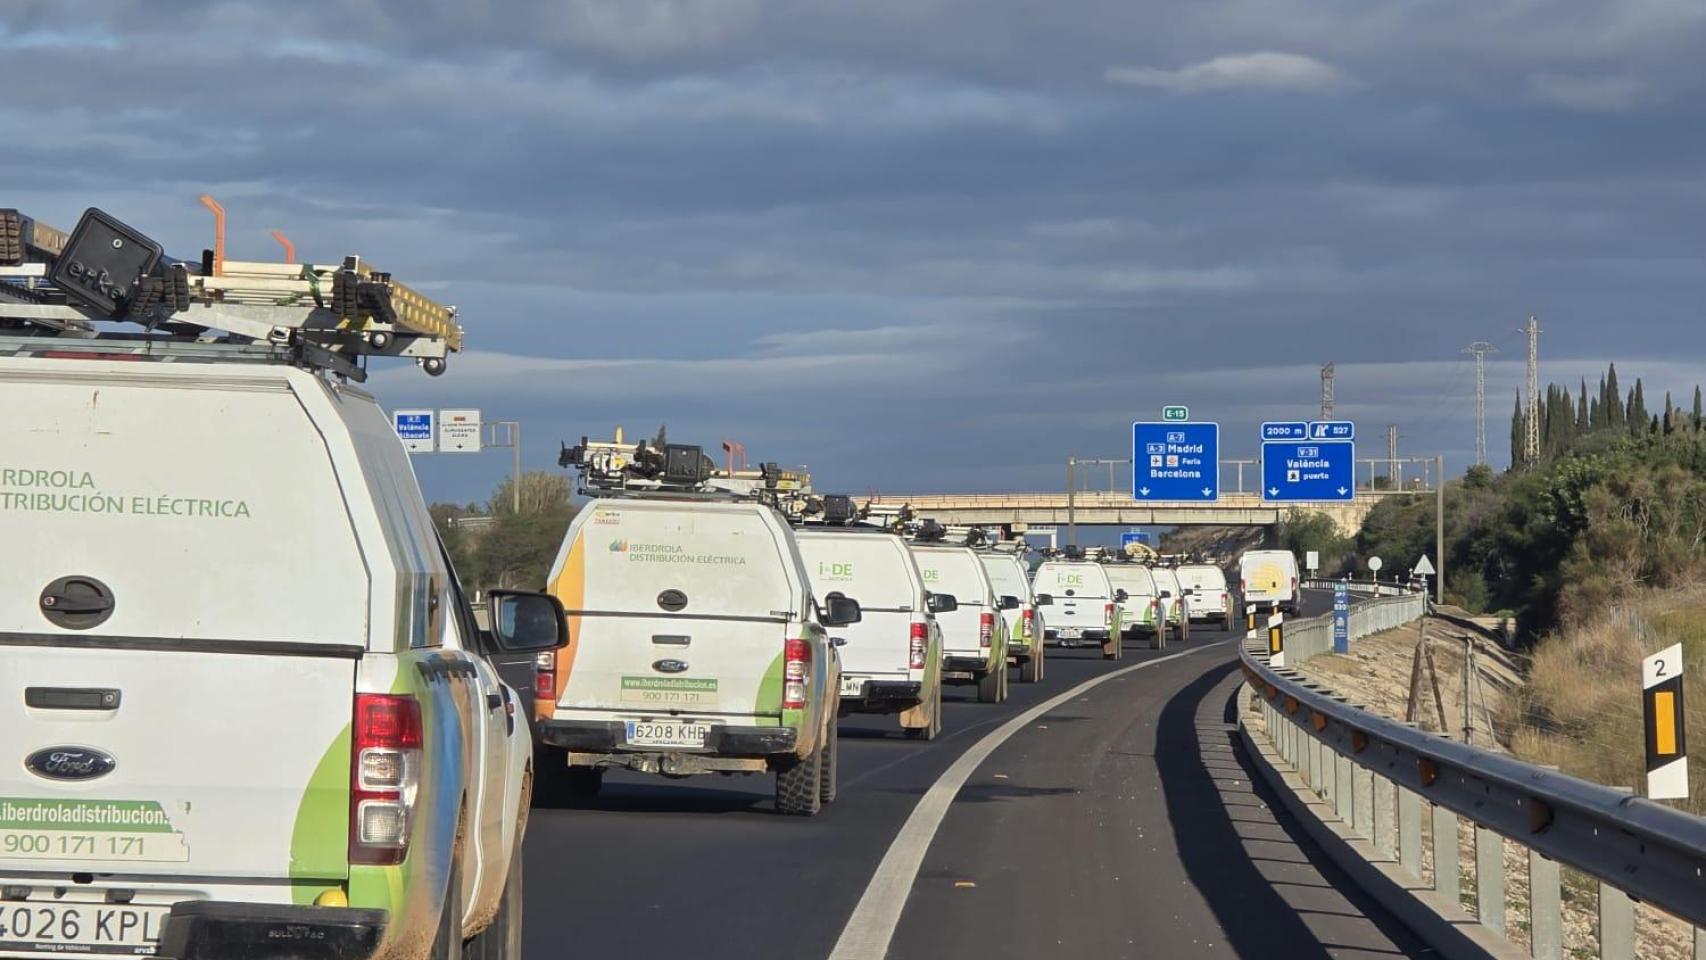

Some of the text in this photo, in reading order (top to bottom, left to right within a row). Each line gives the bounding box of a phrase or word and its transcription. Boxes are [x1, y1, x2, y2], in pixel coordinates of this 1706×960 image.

[1266, 427, 1291, 435] 2000
[1167, 444, 1203, 453] Madrid
[1182, 457, 1201, 465] Feria
[1286, 459, 1330, 468] València
[1150, 469, 1201, 478] Barcelona
[1303, 472, 1329, 480] puerto
[0, 491, 251, 518] TRIBUCIÓN ELÉCTRICA
[630, 544, 683, 553] IBERDROLA
[629, 552, 746, 565] DISTRIBUCIÓN ELÉCTRICA
[1654, 659, 1667, 677] 2
[643, 691, 700, 701] 900 171 171
[636, 725, 706, 739] 6208 KHB
[45, 751, 95, 773] Ford
[4, 834, 145, 855] 900 171 171
[95, 909, 161, 943] KPL
